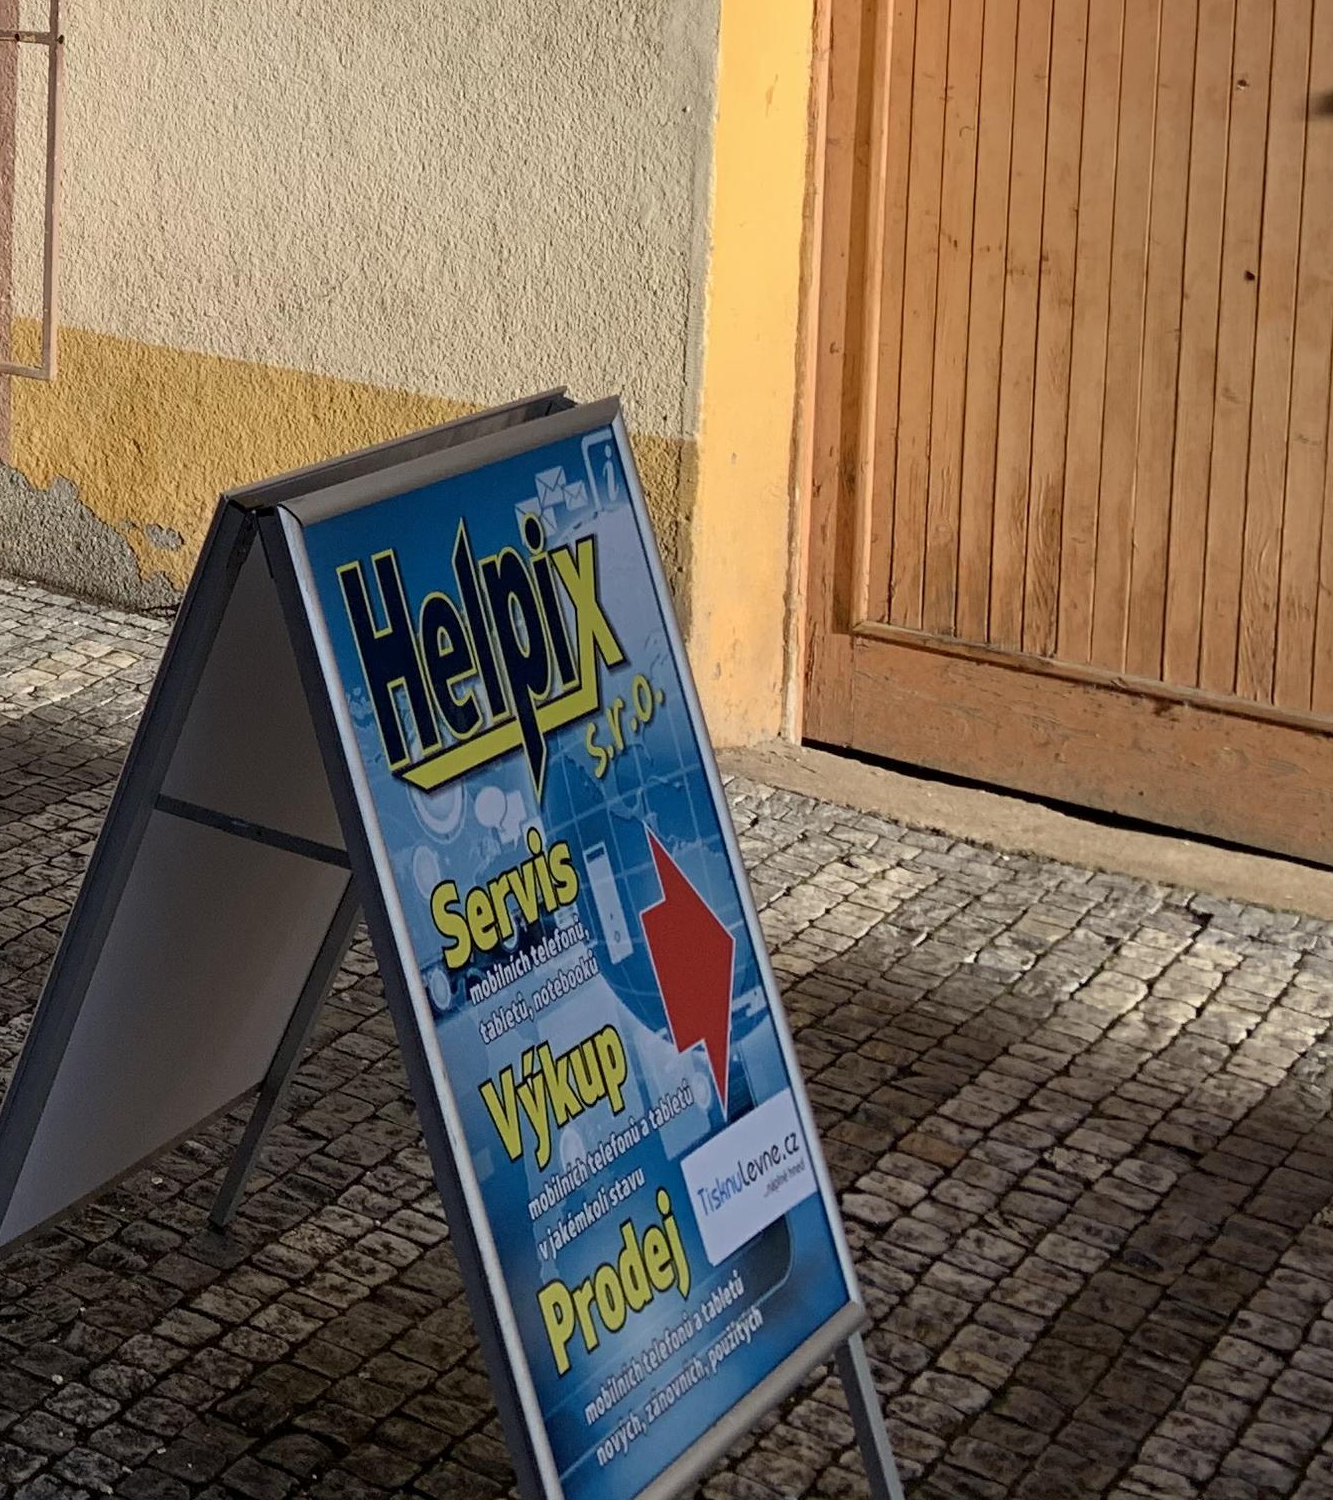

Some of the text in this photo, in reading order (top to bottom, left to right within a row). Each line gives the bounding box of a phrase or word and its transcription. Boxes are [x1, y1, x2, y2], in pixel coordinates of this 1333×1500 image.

[336, 516, 666, 807] Helpix s.r.o.
[430, 825, 579, 970] Servis
[469, 913, 590, 1005] mobilních telefonů,
[479, 948, 599, 1045] tabletů, notebooků
[478, 1024, 628, 1173] Výkup
[527, 1078, 695, 1221] mobilních telefonů a tabletů
[537, 1187, 693, 1379] Prodej
[539, 1167, 646, 1261] v jakémkoli stavu
[584, 1269, 745, 1427] mobilních telefonů a tabletů
[596, 1304, 763, 1467] nových, zánovních, použitých
